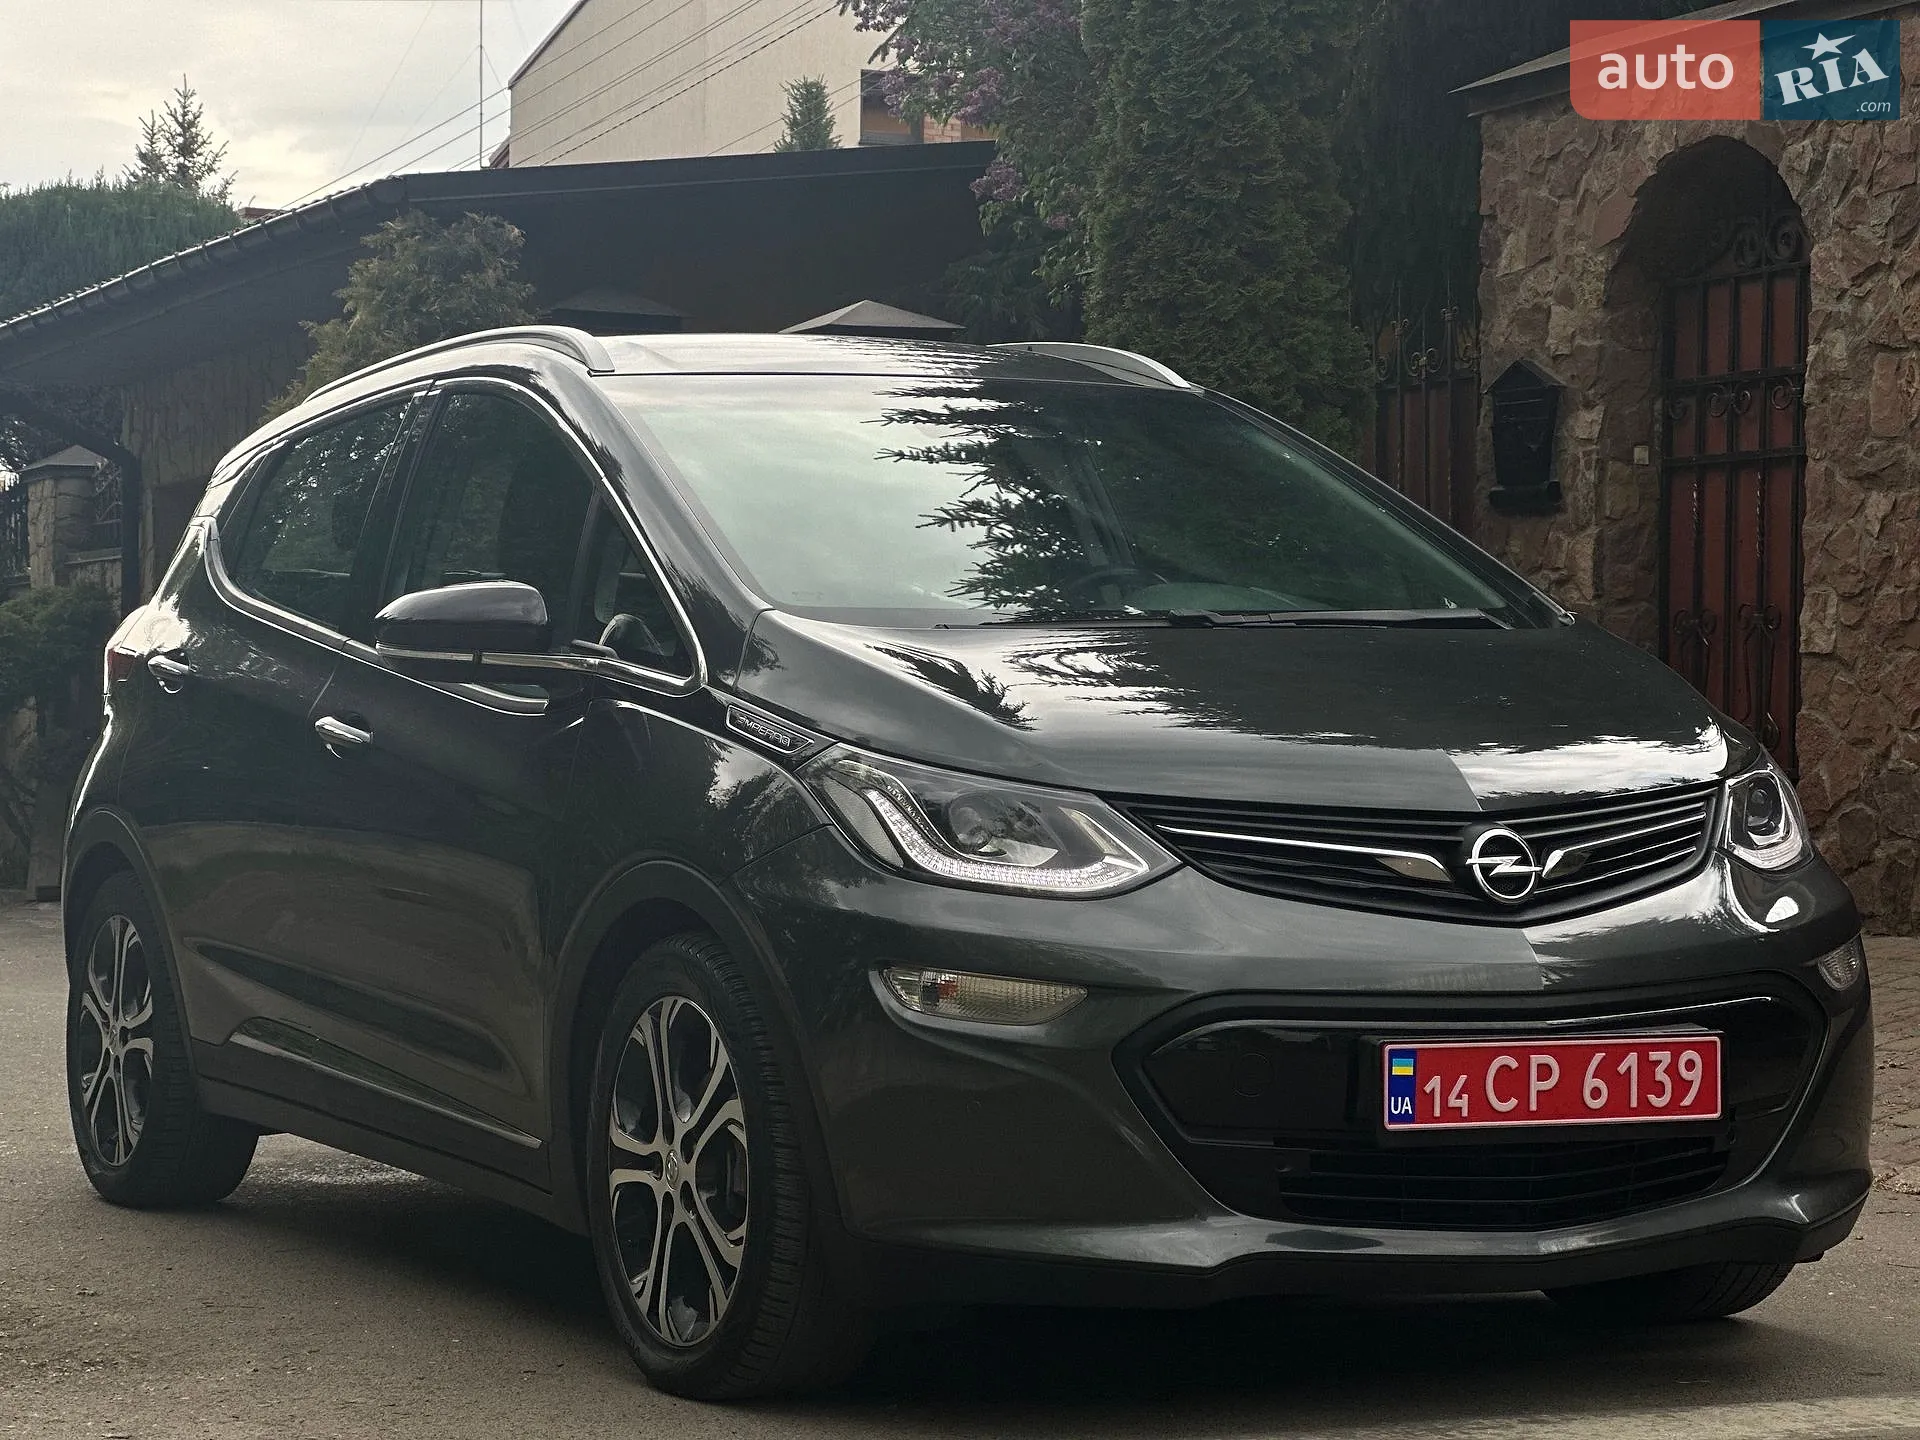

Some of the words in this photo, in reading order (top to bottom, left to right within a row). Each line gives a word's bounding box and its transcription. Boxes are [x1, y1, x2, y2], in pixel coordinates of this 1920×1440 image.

[1423, 1074, 1468, 1117] 14
[1485, 1055, 1560, 1113] CP
[1582, 1050, 1704, 1110] 6139
[1390, 1096, 1413, 1115] UA
